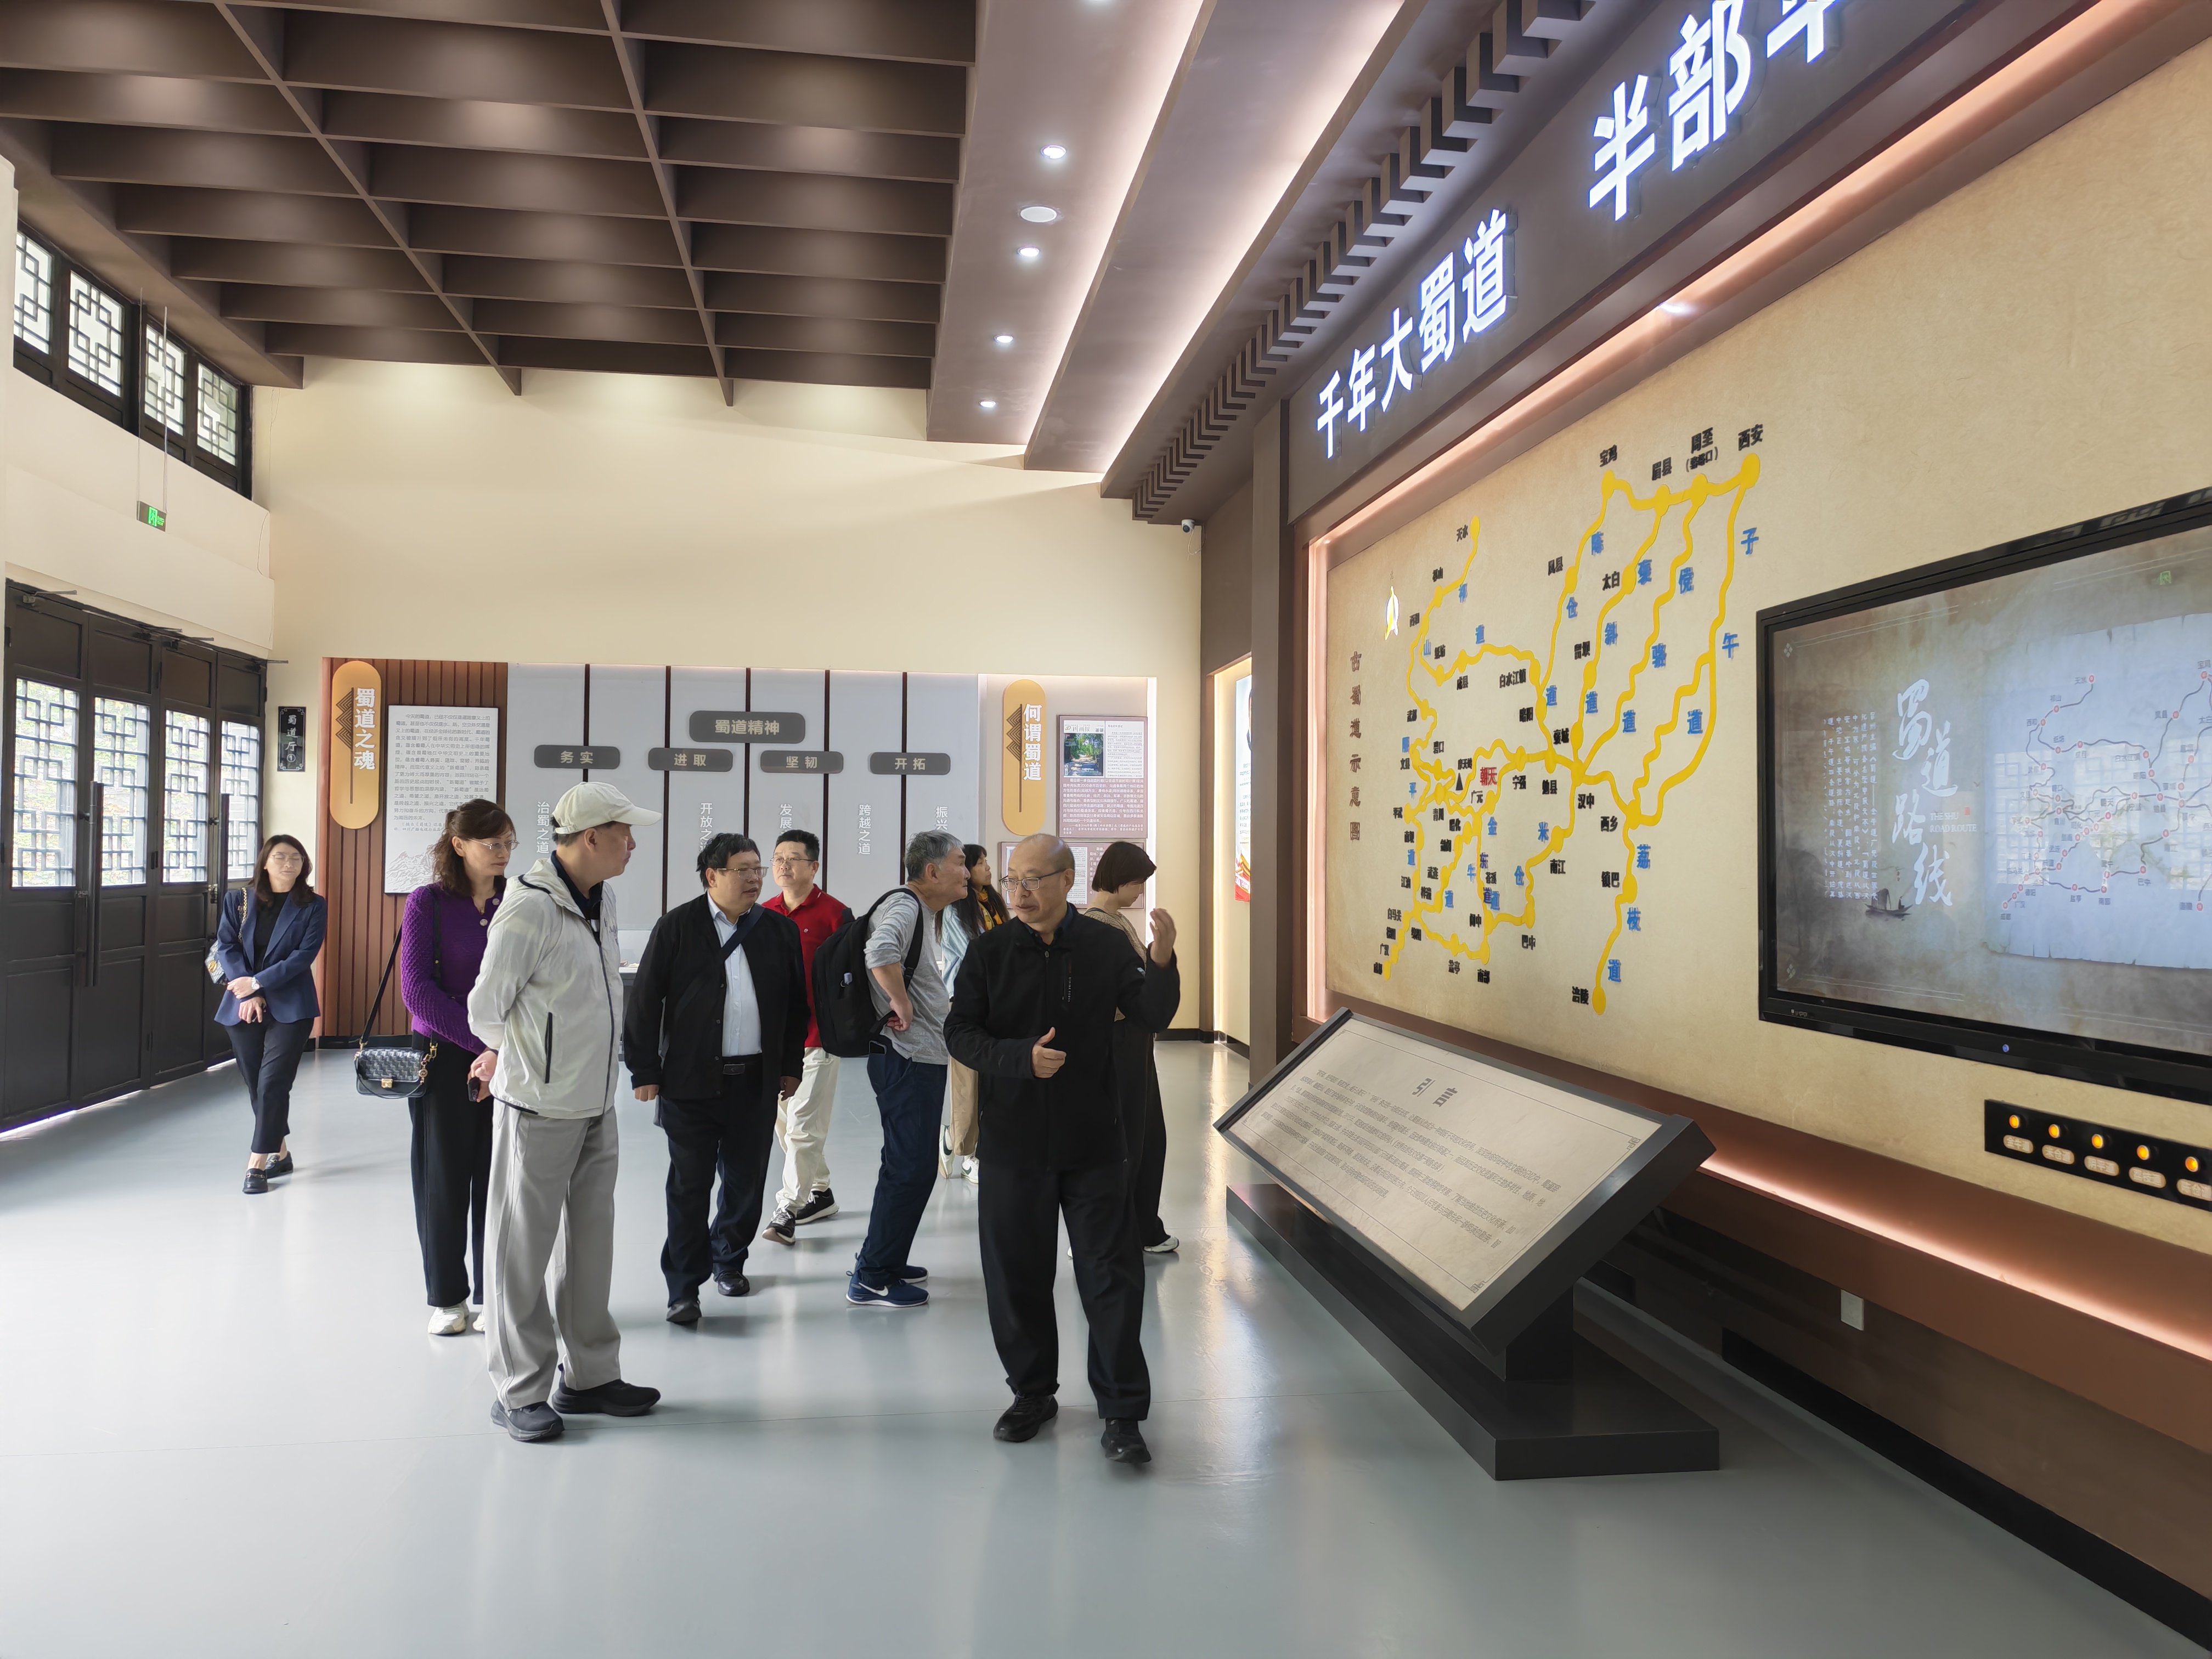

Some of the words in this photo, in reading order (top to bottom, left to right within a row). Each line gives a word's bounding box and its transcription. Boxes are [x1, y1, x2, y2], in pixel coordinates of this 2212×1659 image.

[1317, 208, 1507, 458] 千年大蜀道
[1691, 427, 1713, 454] 周至
[1738, 424, 1763, 450] 西安
[1600, 445, 1617, 467] 宝鸡
[1652, 458, 1672, 481] 眉县
[1457, 525, 1468, 541] 天水
[1741, 528, 1759, 555] 子
[1591, 532, 1604, 556] 陈
[1548, 556, 1563, 575] 凤县
[1638, 560, 1652, 585] 褒
[1602, 571, 1620, 590] 太白
[1566, 597, 1578, 618] 仓
[1409, 613, 1419, 627] 西和
[1424, 639, 1431, 656] 山
[1475, 624, 1485, 644] 道
[1605, 621, 1618, 645] 斜
[1575, 641, 1590, 659] 留坝
[1722, 633, 1739, 658] 午
[1457, 676, 1469, 690] 成县
[1499, 669, 1526, 689] 白水江镇
[2074, 676, 2087, 685] 天水
[1546, 685, 1557, 706] 道
[1585, 691, 1598, 714] 道
[1520, 707, 1533, 723] 略阳
[1622, 710, 1636, 733] 道
[1687, 709, 1703, 734] 道
[354, 687, 375, 770] 蜀道之魂
[715, 719, 779, 736] 蜀道精神
[1553, 728, 1570, 745] 褒城
[1023, 704, 1042, 781] 何谓蜀道
[1350, 651, 1362, 840] 古蜀道示意图
[1433, 741, 1444, 754] 碧口
[560, 751, 594, 765] 务实
[674, 753, 707, 767] 进取
[786, 755, 818, 769] 坚韧
[894, 757, 926, 771] 开拓
[1400, 758, 1410, 770] 文县
[1480, 767, 1498, 786] 朝天
[1513, 775, 1526, 790] 宁强
[1409, 782, 1417, 799] 平
[1542, 779, 1558, 795] 勉县
[1471, 790, 1483, 804] 广元
[1578, 793, 1595, 809] 汉中
[780, 804, 793, 834] 发展
[1433, 808, 1444, 821] 青川
[1600, 816, 1618, 832] 西乡
[536, 801, 550, 854] 治蜀之道
[858, 804, 871, 855] 跨越之道
[1449, 819, 1461, 832] 昭化
[1487, 816, 1498, 836] 金
[1538, 822, 1549, 842] 米
[1930, 825, 1950, 833] ROAD
[1951, 823, 1977, 832] ROUTE
[1467, 862, 1476, 883] 牛
[1514, 865, 1524, 886] 仓
[1550, 859, 1566, 875] 南江
[1601, 871, 1620, 888] 镇巴
[2137, 878, 2151, 886] 巴中
[1627, 907, 1641, 932] 枝
[1522, 934, 1536, 950] 巴中
[1608, 959, 1622, 983] 道
[1572, 986, 1589, 1005] 涪陵
[1412, 1077, 1458, 1107] 引言
